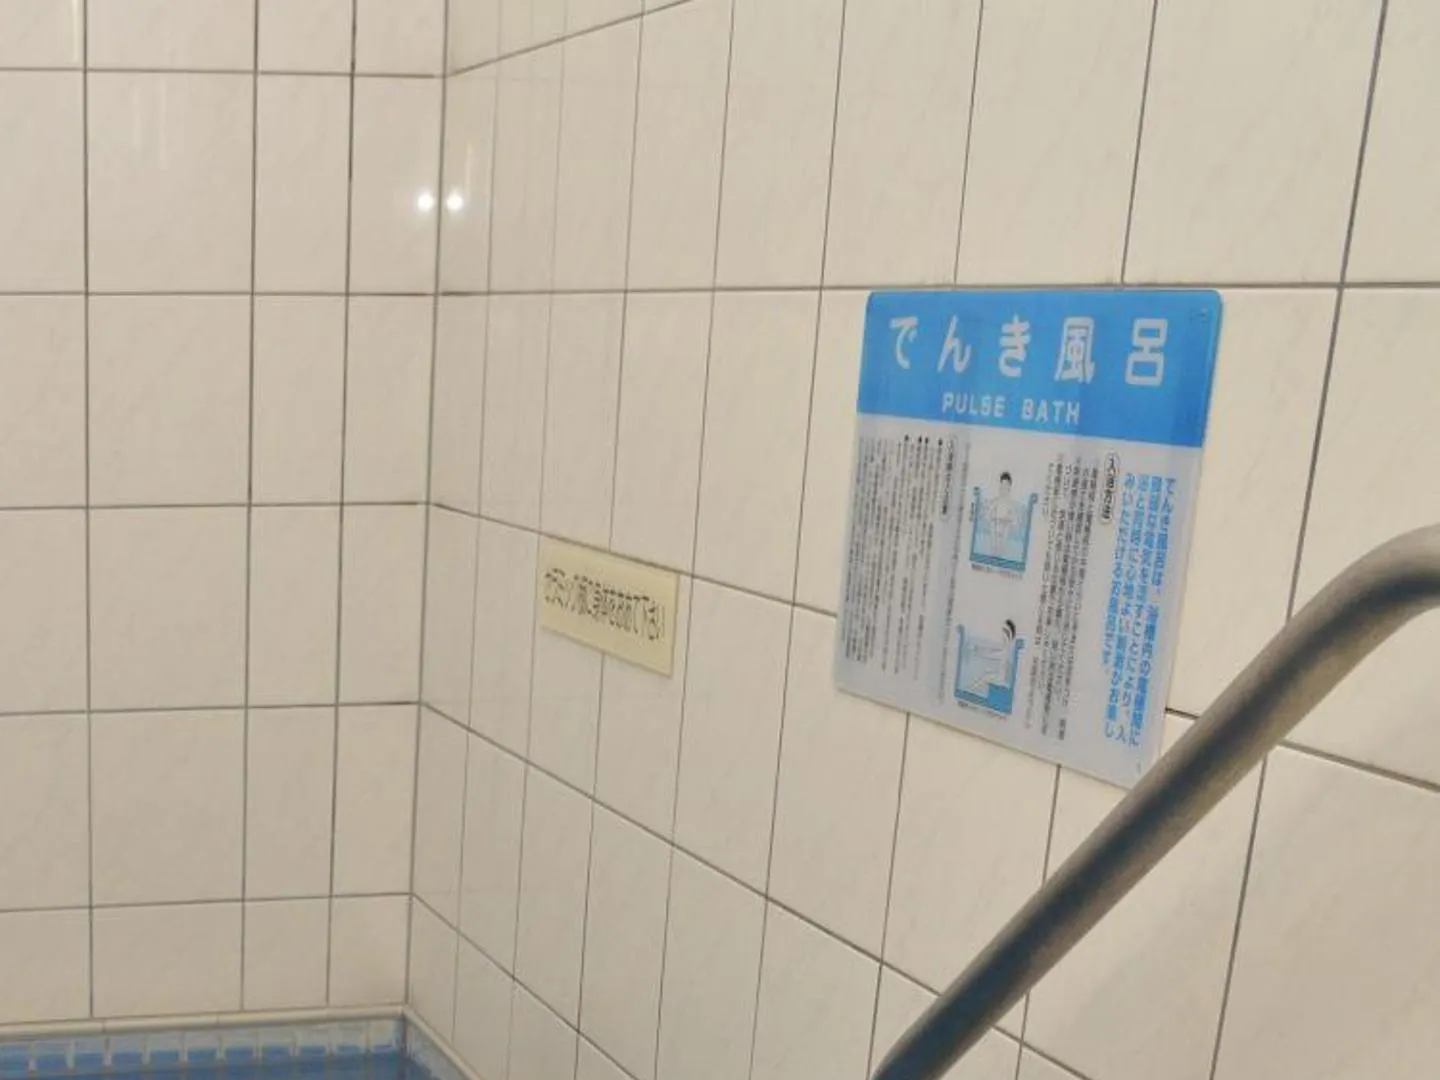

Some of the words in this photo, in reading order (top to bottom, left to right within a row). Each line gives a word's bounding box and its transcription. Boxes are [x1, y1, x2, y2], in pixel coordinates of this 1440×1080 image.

[889, 313, 1169, 387] でんき風呂
[941, 391, 1006, 418] PULSE
[1021, 398, 1081, 426] BATH
